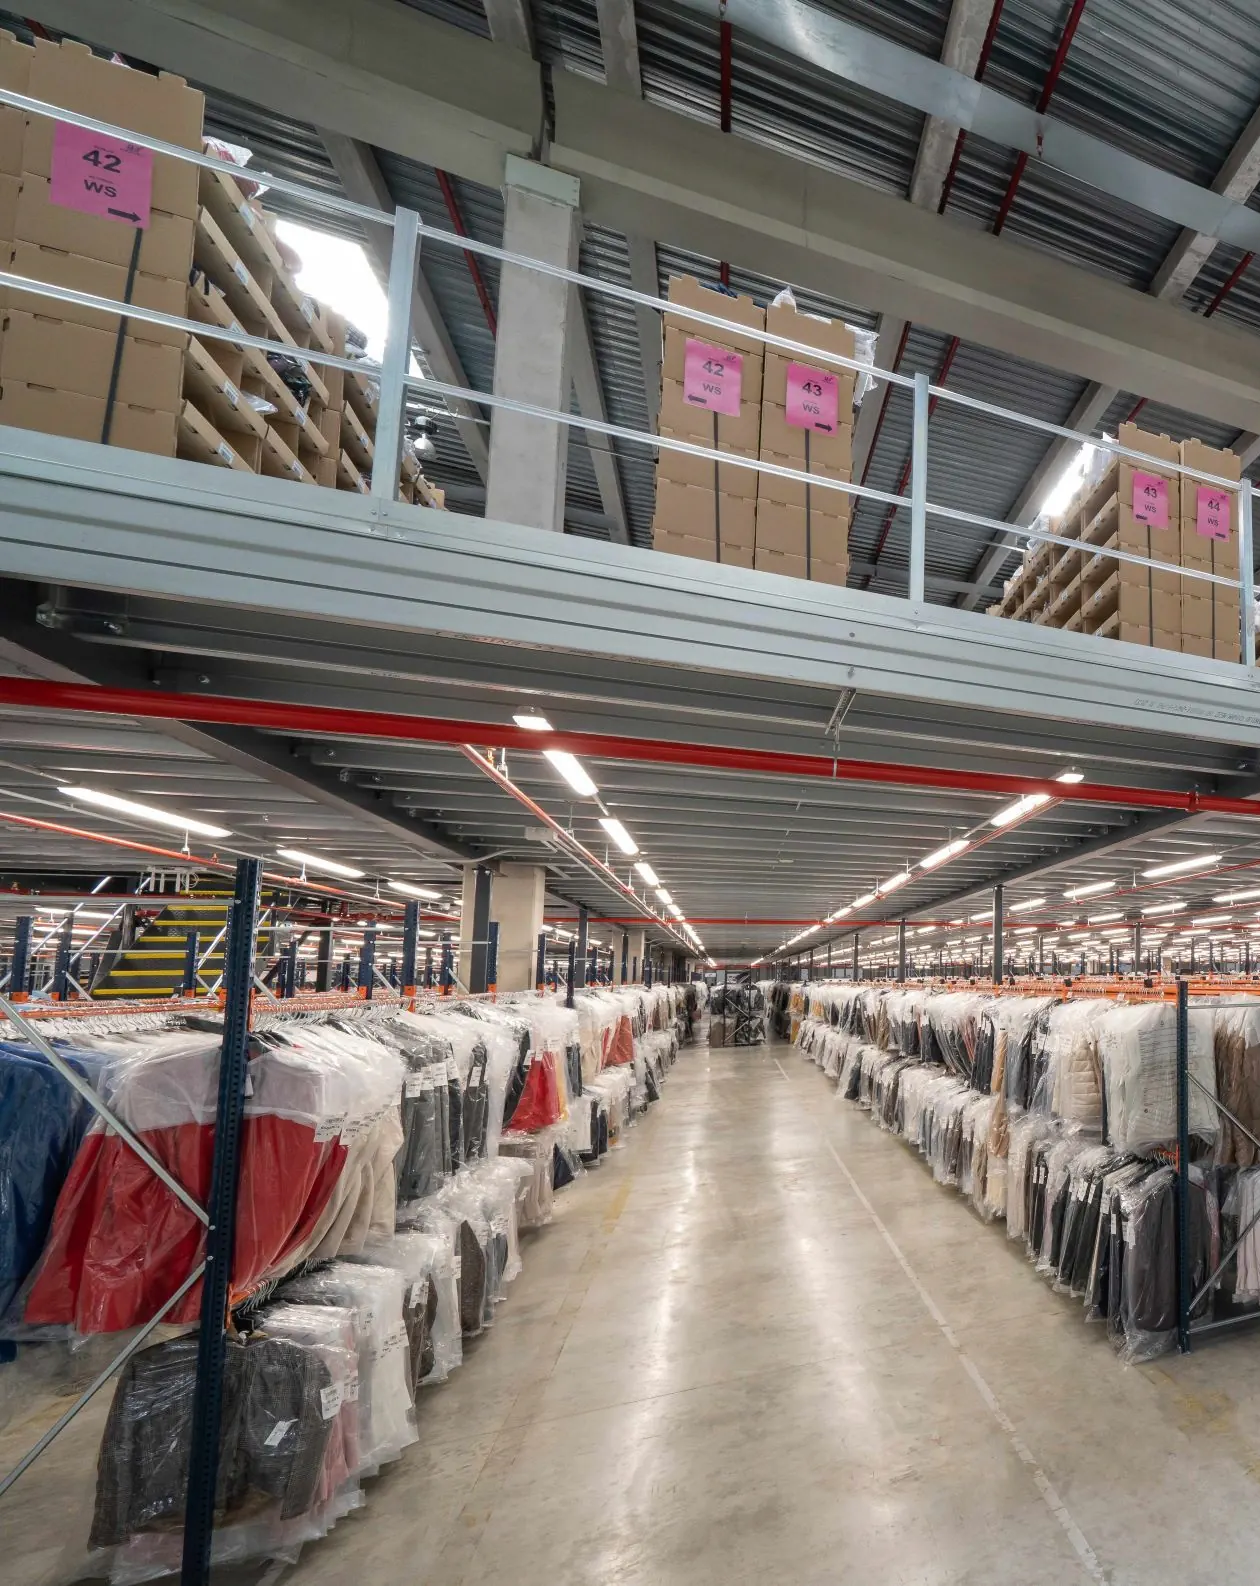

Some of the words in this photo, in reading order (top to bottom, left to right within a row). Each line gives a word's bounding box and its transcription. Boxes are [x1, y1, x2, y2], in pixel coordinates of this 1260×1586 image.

[82, 149, 121, 174] 42
[84, 179, 118, 198] WS
[702, 360, 724, 377] 42
[702, 383, 722, 396] WS
[802, 382, 822, 397] 43
[802, 403, 820, 415] WS
[1143, 486, 1158, 499] 43
[1144, 504, 1157, 514] WS
[1207, 500, 1220, 512] 44
[1207, 518, 1219, 527] WS
